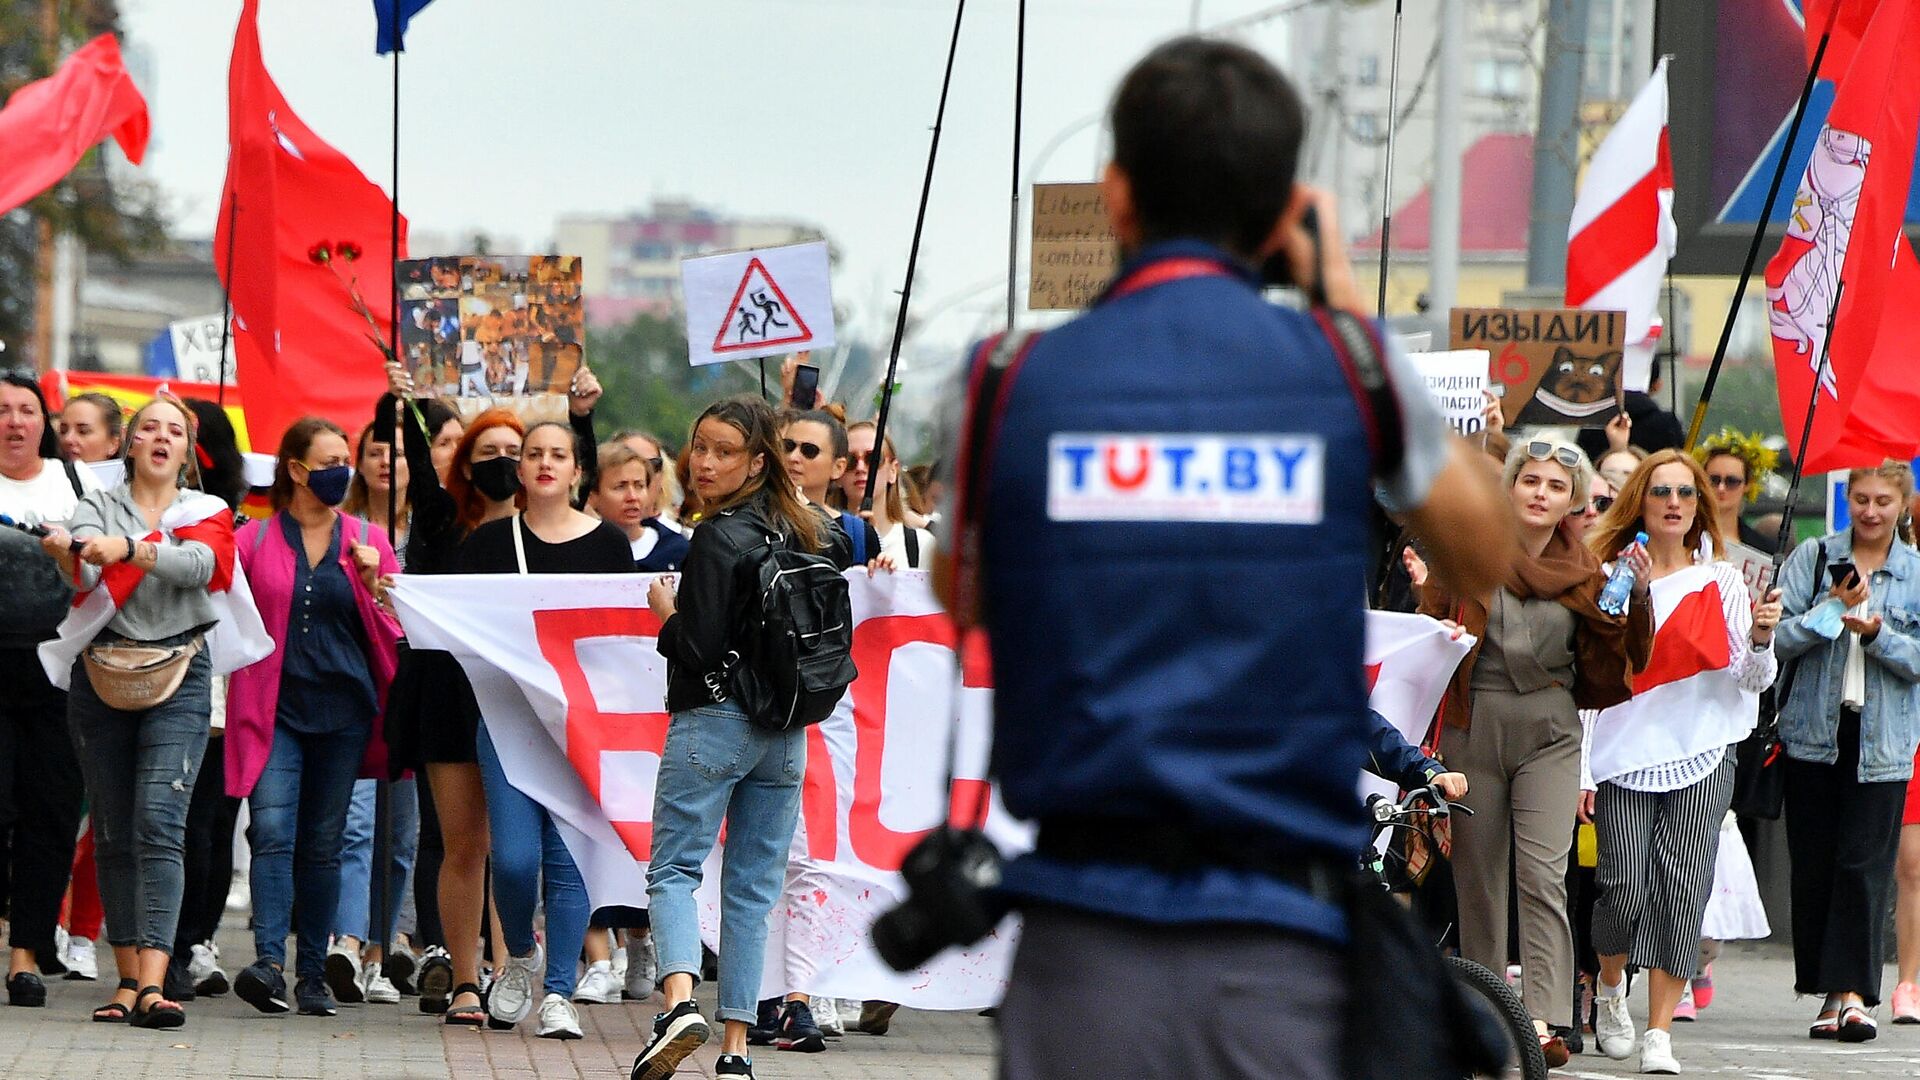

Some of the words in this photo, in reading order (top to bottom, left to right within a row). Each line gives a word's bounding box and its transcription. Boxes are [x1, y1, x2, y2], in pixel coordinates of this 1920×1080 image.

[1463, 313, 1614, 345] ИЗЫДИ!
[1488, 342, 1530, 385] 6
[1063, 446, 1307, 491] TUT.BY
